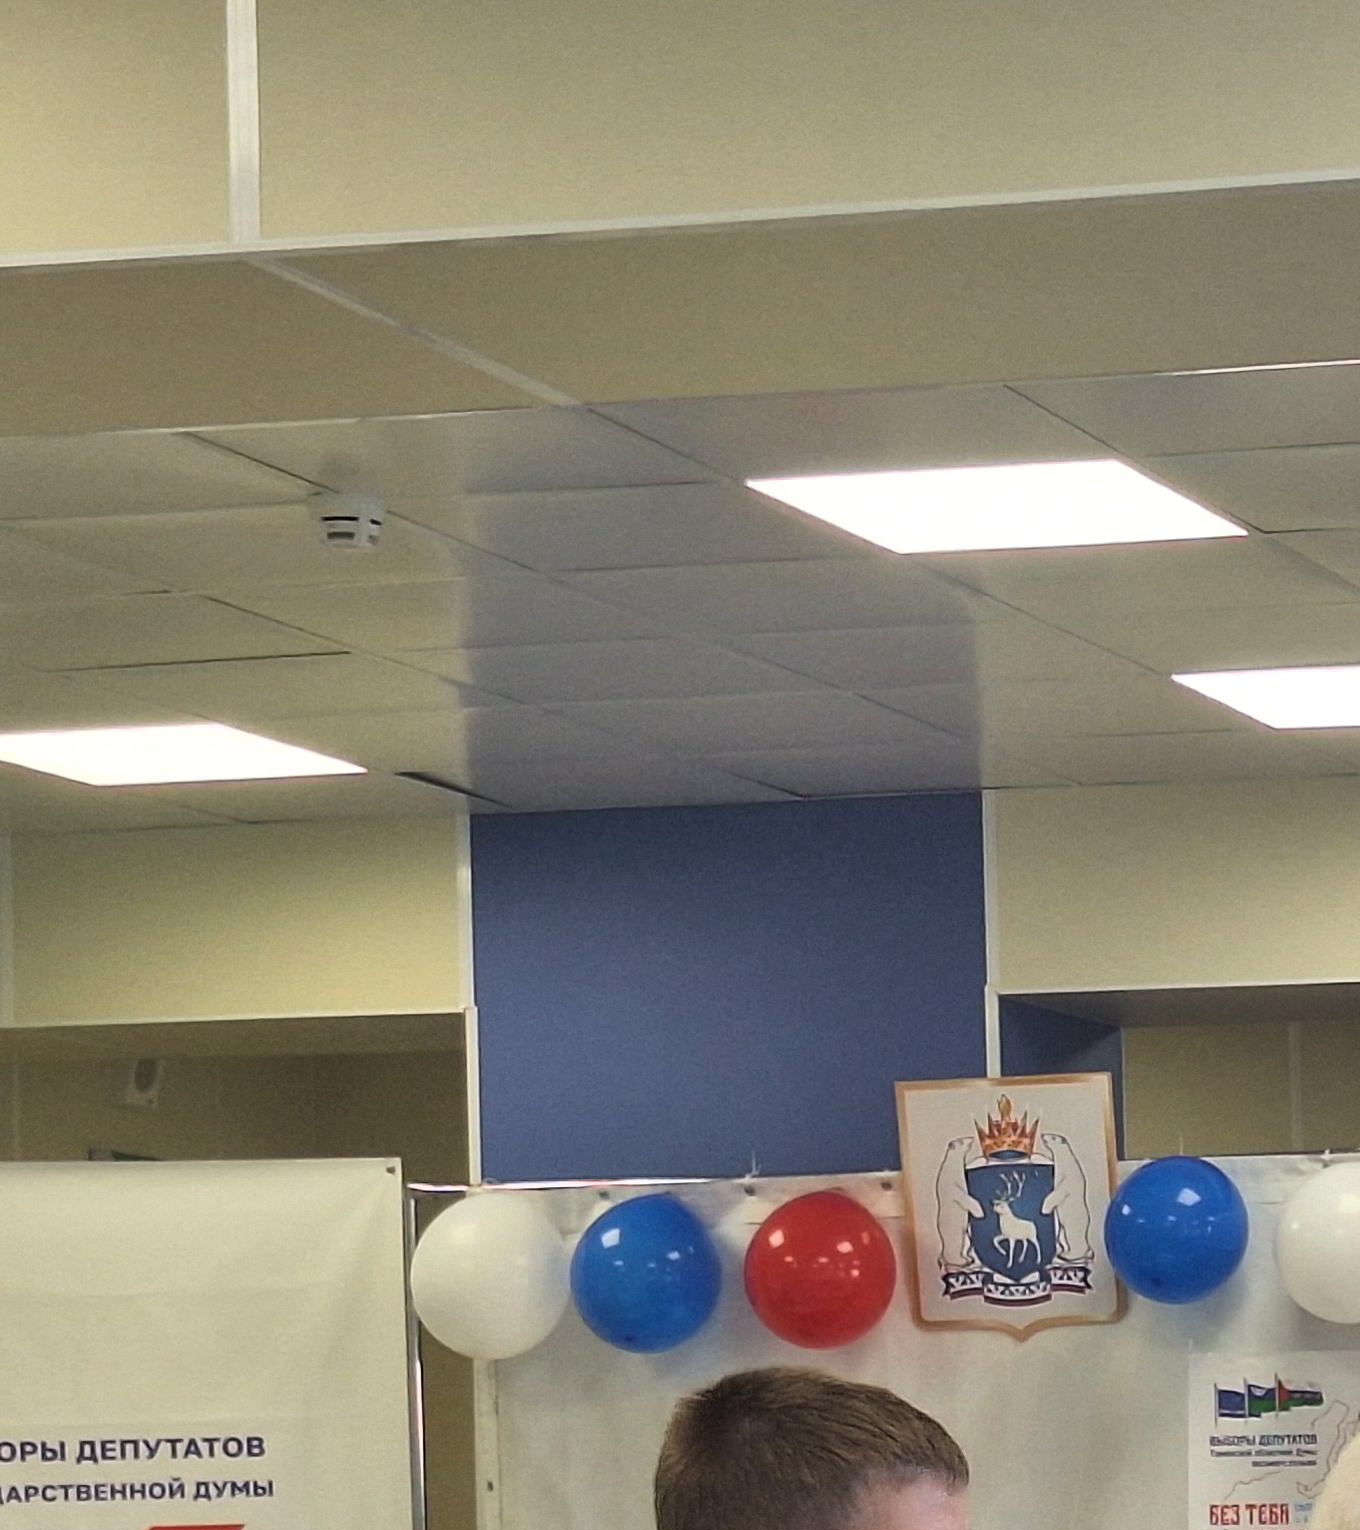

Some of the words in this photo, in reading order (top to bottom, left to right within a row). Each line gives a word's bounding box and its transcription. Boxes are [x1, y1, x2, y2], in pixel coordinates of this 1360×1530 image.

[0, 1441, 66, 1463] ОРЫ
[76, 1436, 266, 1465] ДЕПУТАТОВ
[0, 1476, 186, 1505] АРСТВЕННОЙ
[193, 1479, 275, 1501] ДУМЫ
[1210, 1504, 1240, 1526] БЕЗ
[1246, 1504, 1289, 1525] ТЕБЯ
